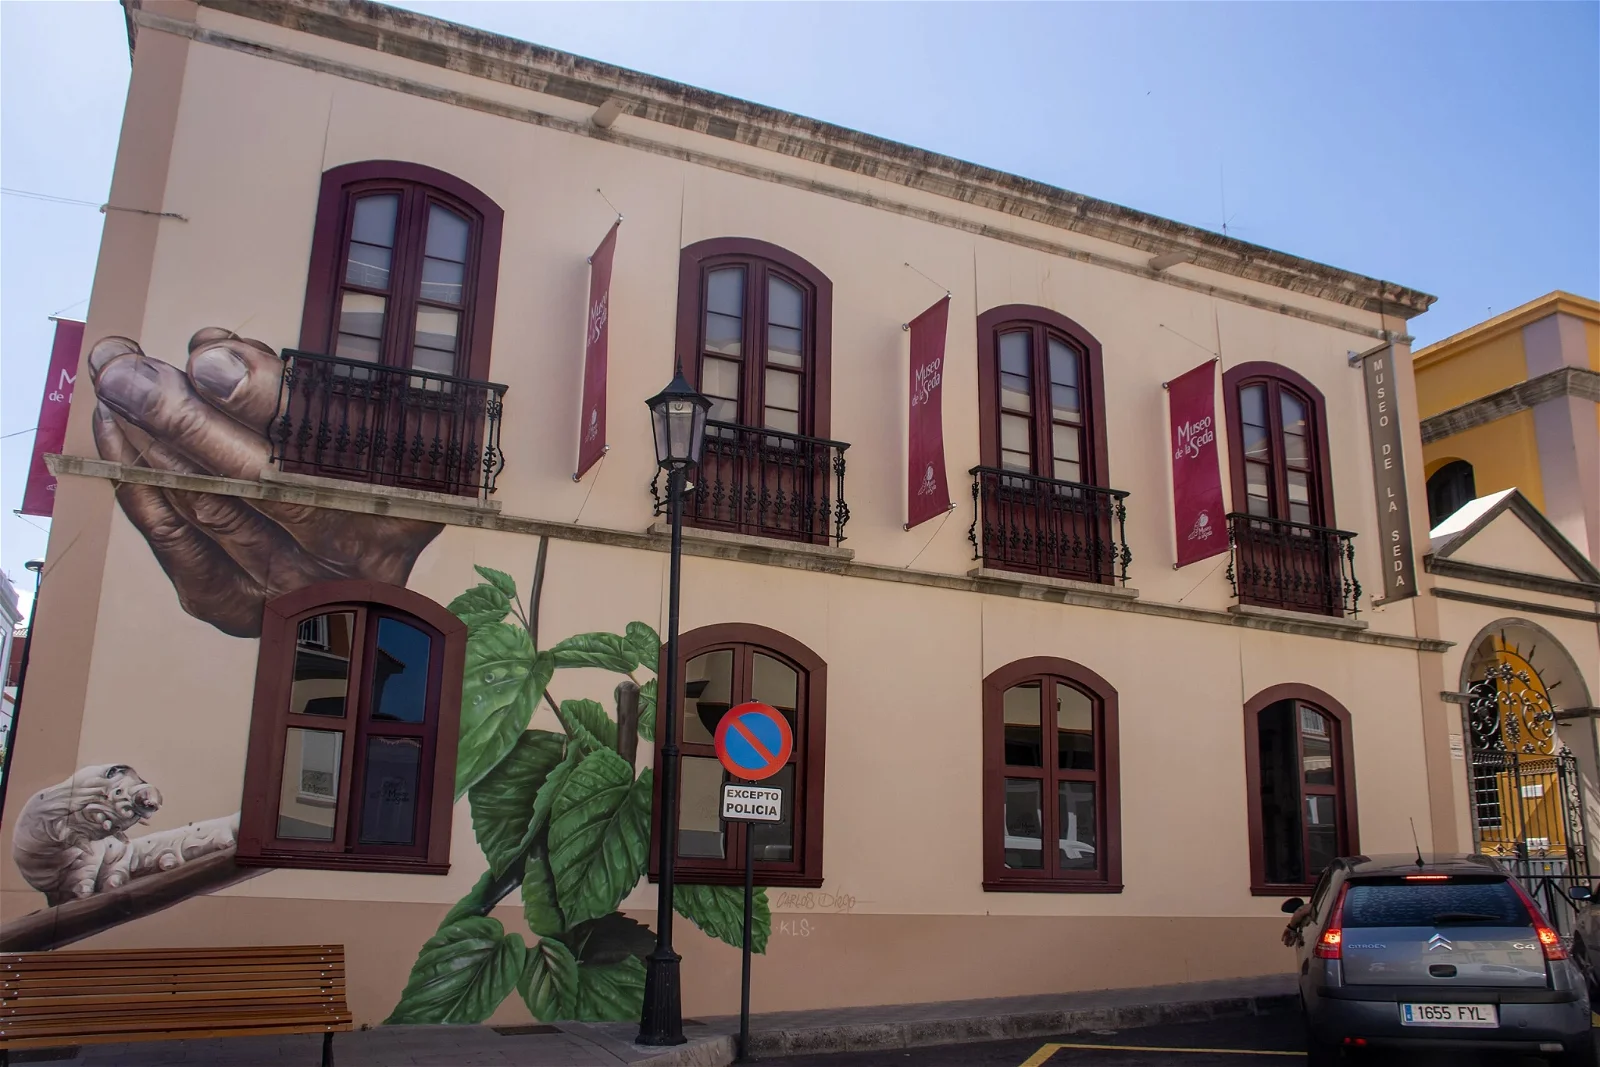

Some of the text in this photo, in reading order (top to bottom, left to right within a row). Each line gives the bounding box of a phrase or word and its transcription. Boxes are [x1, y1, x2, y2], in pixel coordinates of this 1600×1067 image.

[915, 357, 941, 392] Museo
[48, 390, 64, 402] de
[923, 371, 941, 405] Seda
[1177, 416, 1212, 446] Museo
[1174, 428, 1214, 460] de la Seda
[1373, 358, 1405, 587] MUSEO DE LA SEDA
[726, 789, 779, 802] EXCEPTO
[726, 802, 778, 816] POLICIA
[1512, 942, 1537, 951] C4
[1417, 1005, 1452, 1020] 1655
[1457, 1006, 1487, 1021] FYL
